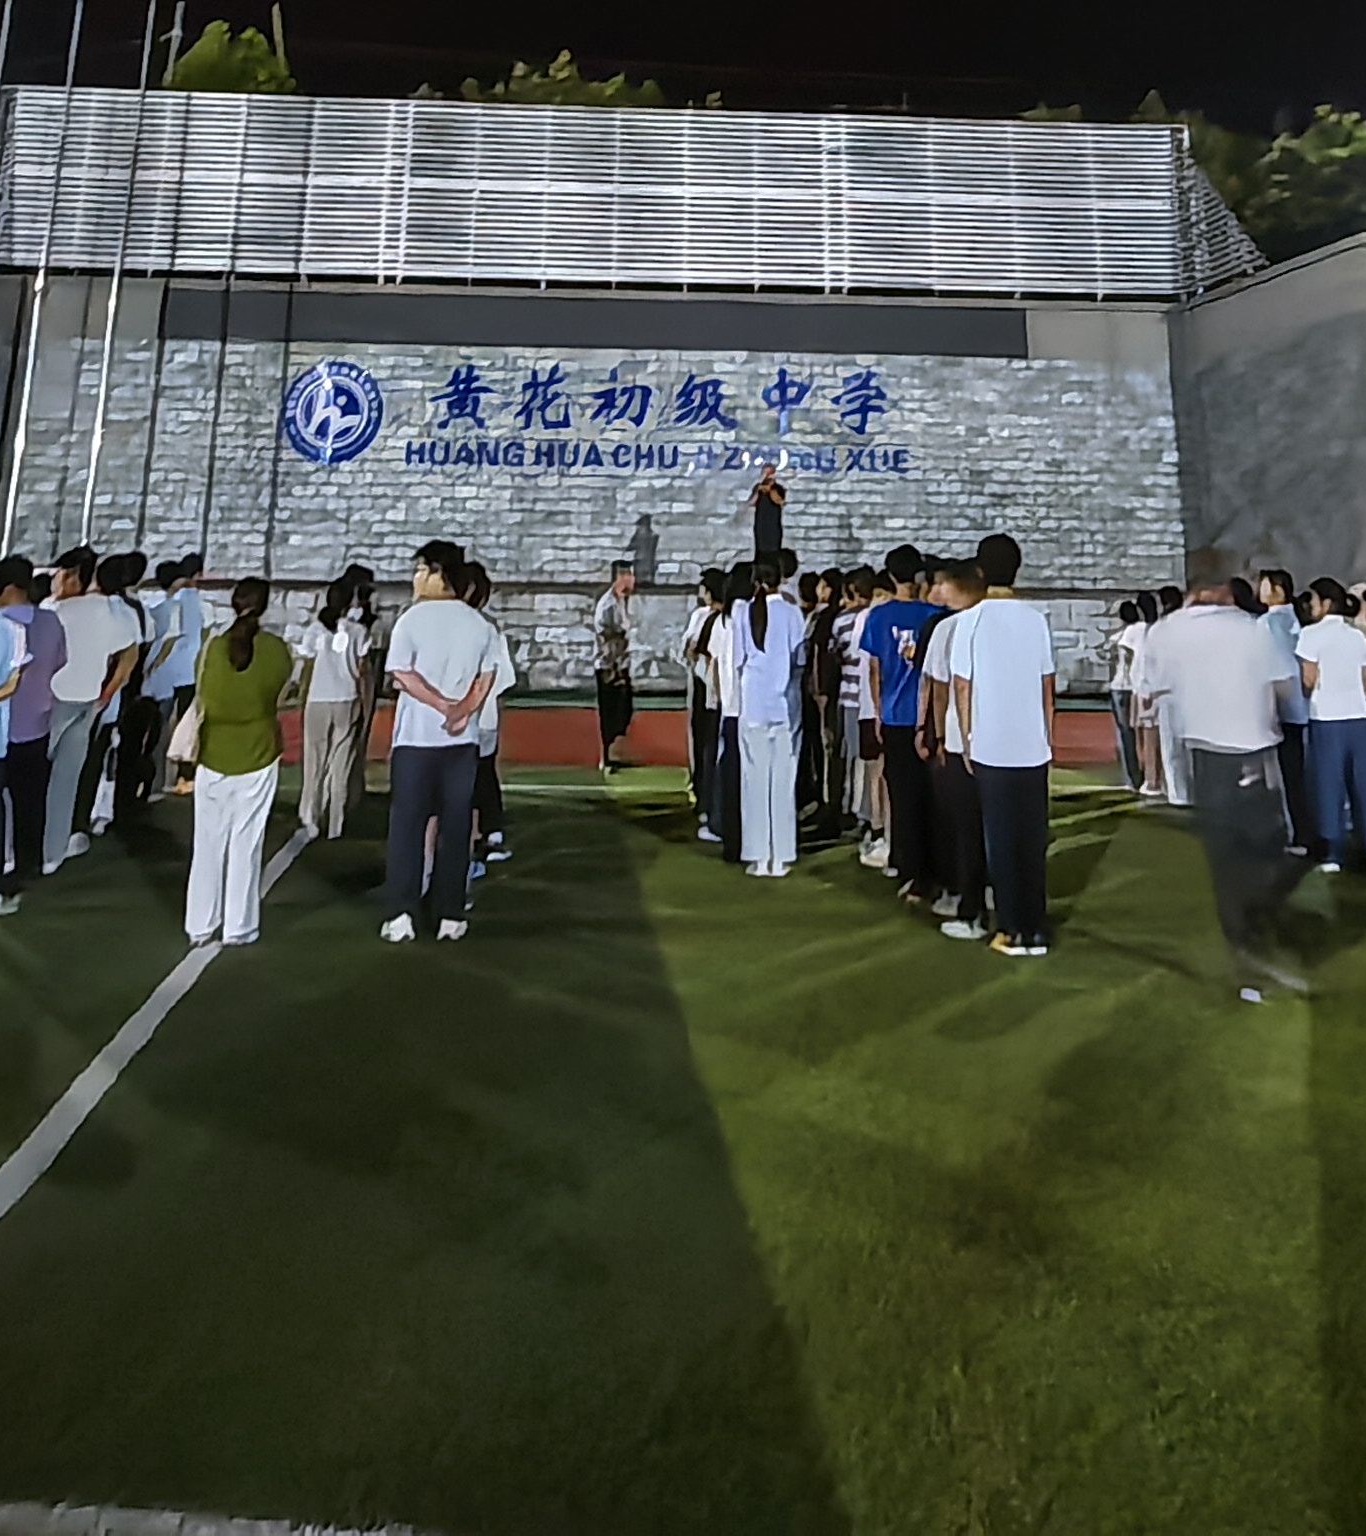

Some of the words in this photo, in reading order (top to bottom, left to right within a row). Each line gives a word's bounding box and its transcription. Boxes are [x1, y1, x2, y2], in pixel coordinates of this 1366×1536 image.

[430, 364, 887, 435] 黄花初级中学
[405, 439, 525, 467] HUANG
[535, 441, 605, 469] HUA
